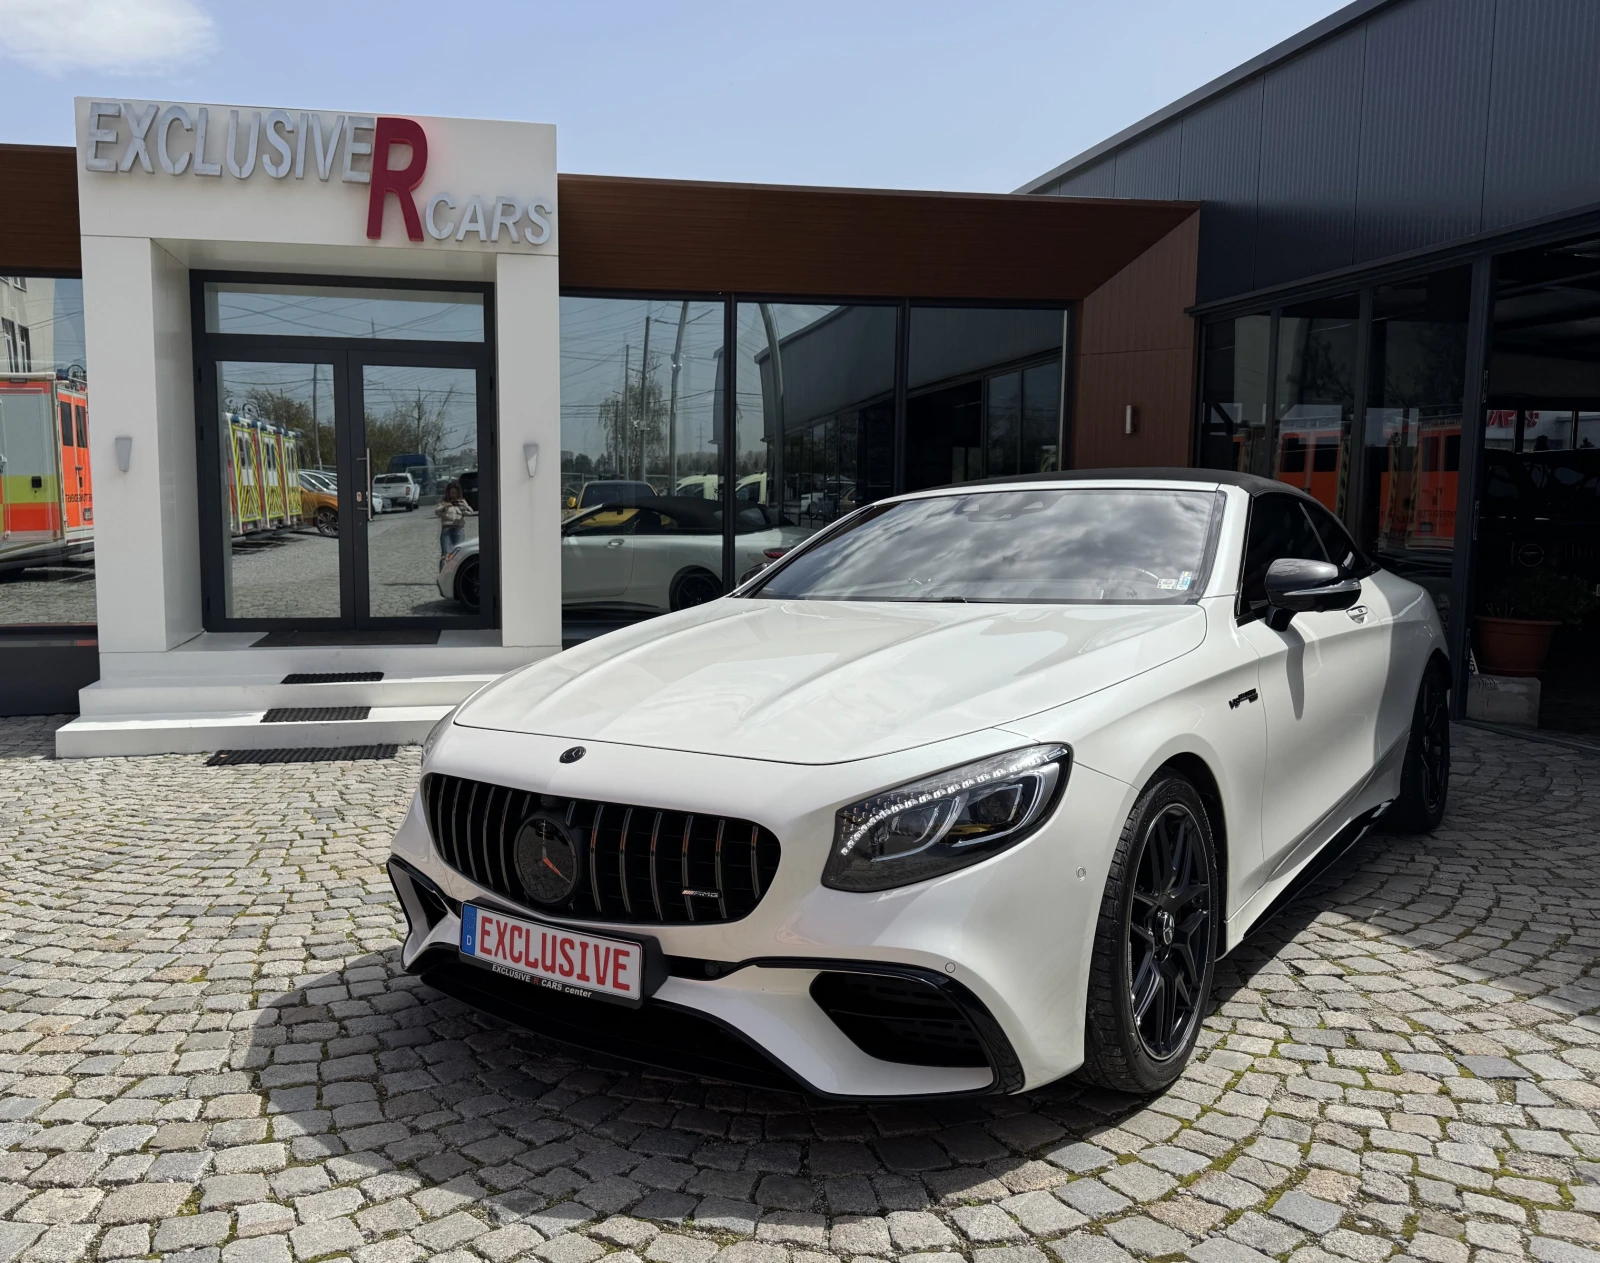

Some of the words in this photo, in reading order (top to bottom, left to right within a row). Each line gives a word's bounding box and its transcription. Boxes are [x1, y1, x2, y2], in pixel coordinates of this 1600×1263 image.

[85, 101, 375, 184] EXCLUSIVE
[366, 116, 428, 242] R
[425, 191, 552, 245] CARS
[467, 935, 472, 945] D
[479, 915, 630, 991] EXCLUSIVE
[492, 964, 531, 983] EXCLUSIVE
[533, 977, 540, 986] R
[541, 979, 563, 991] CARS
[564, 986, 592, 998] center
